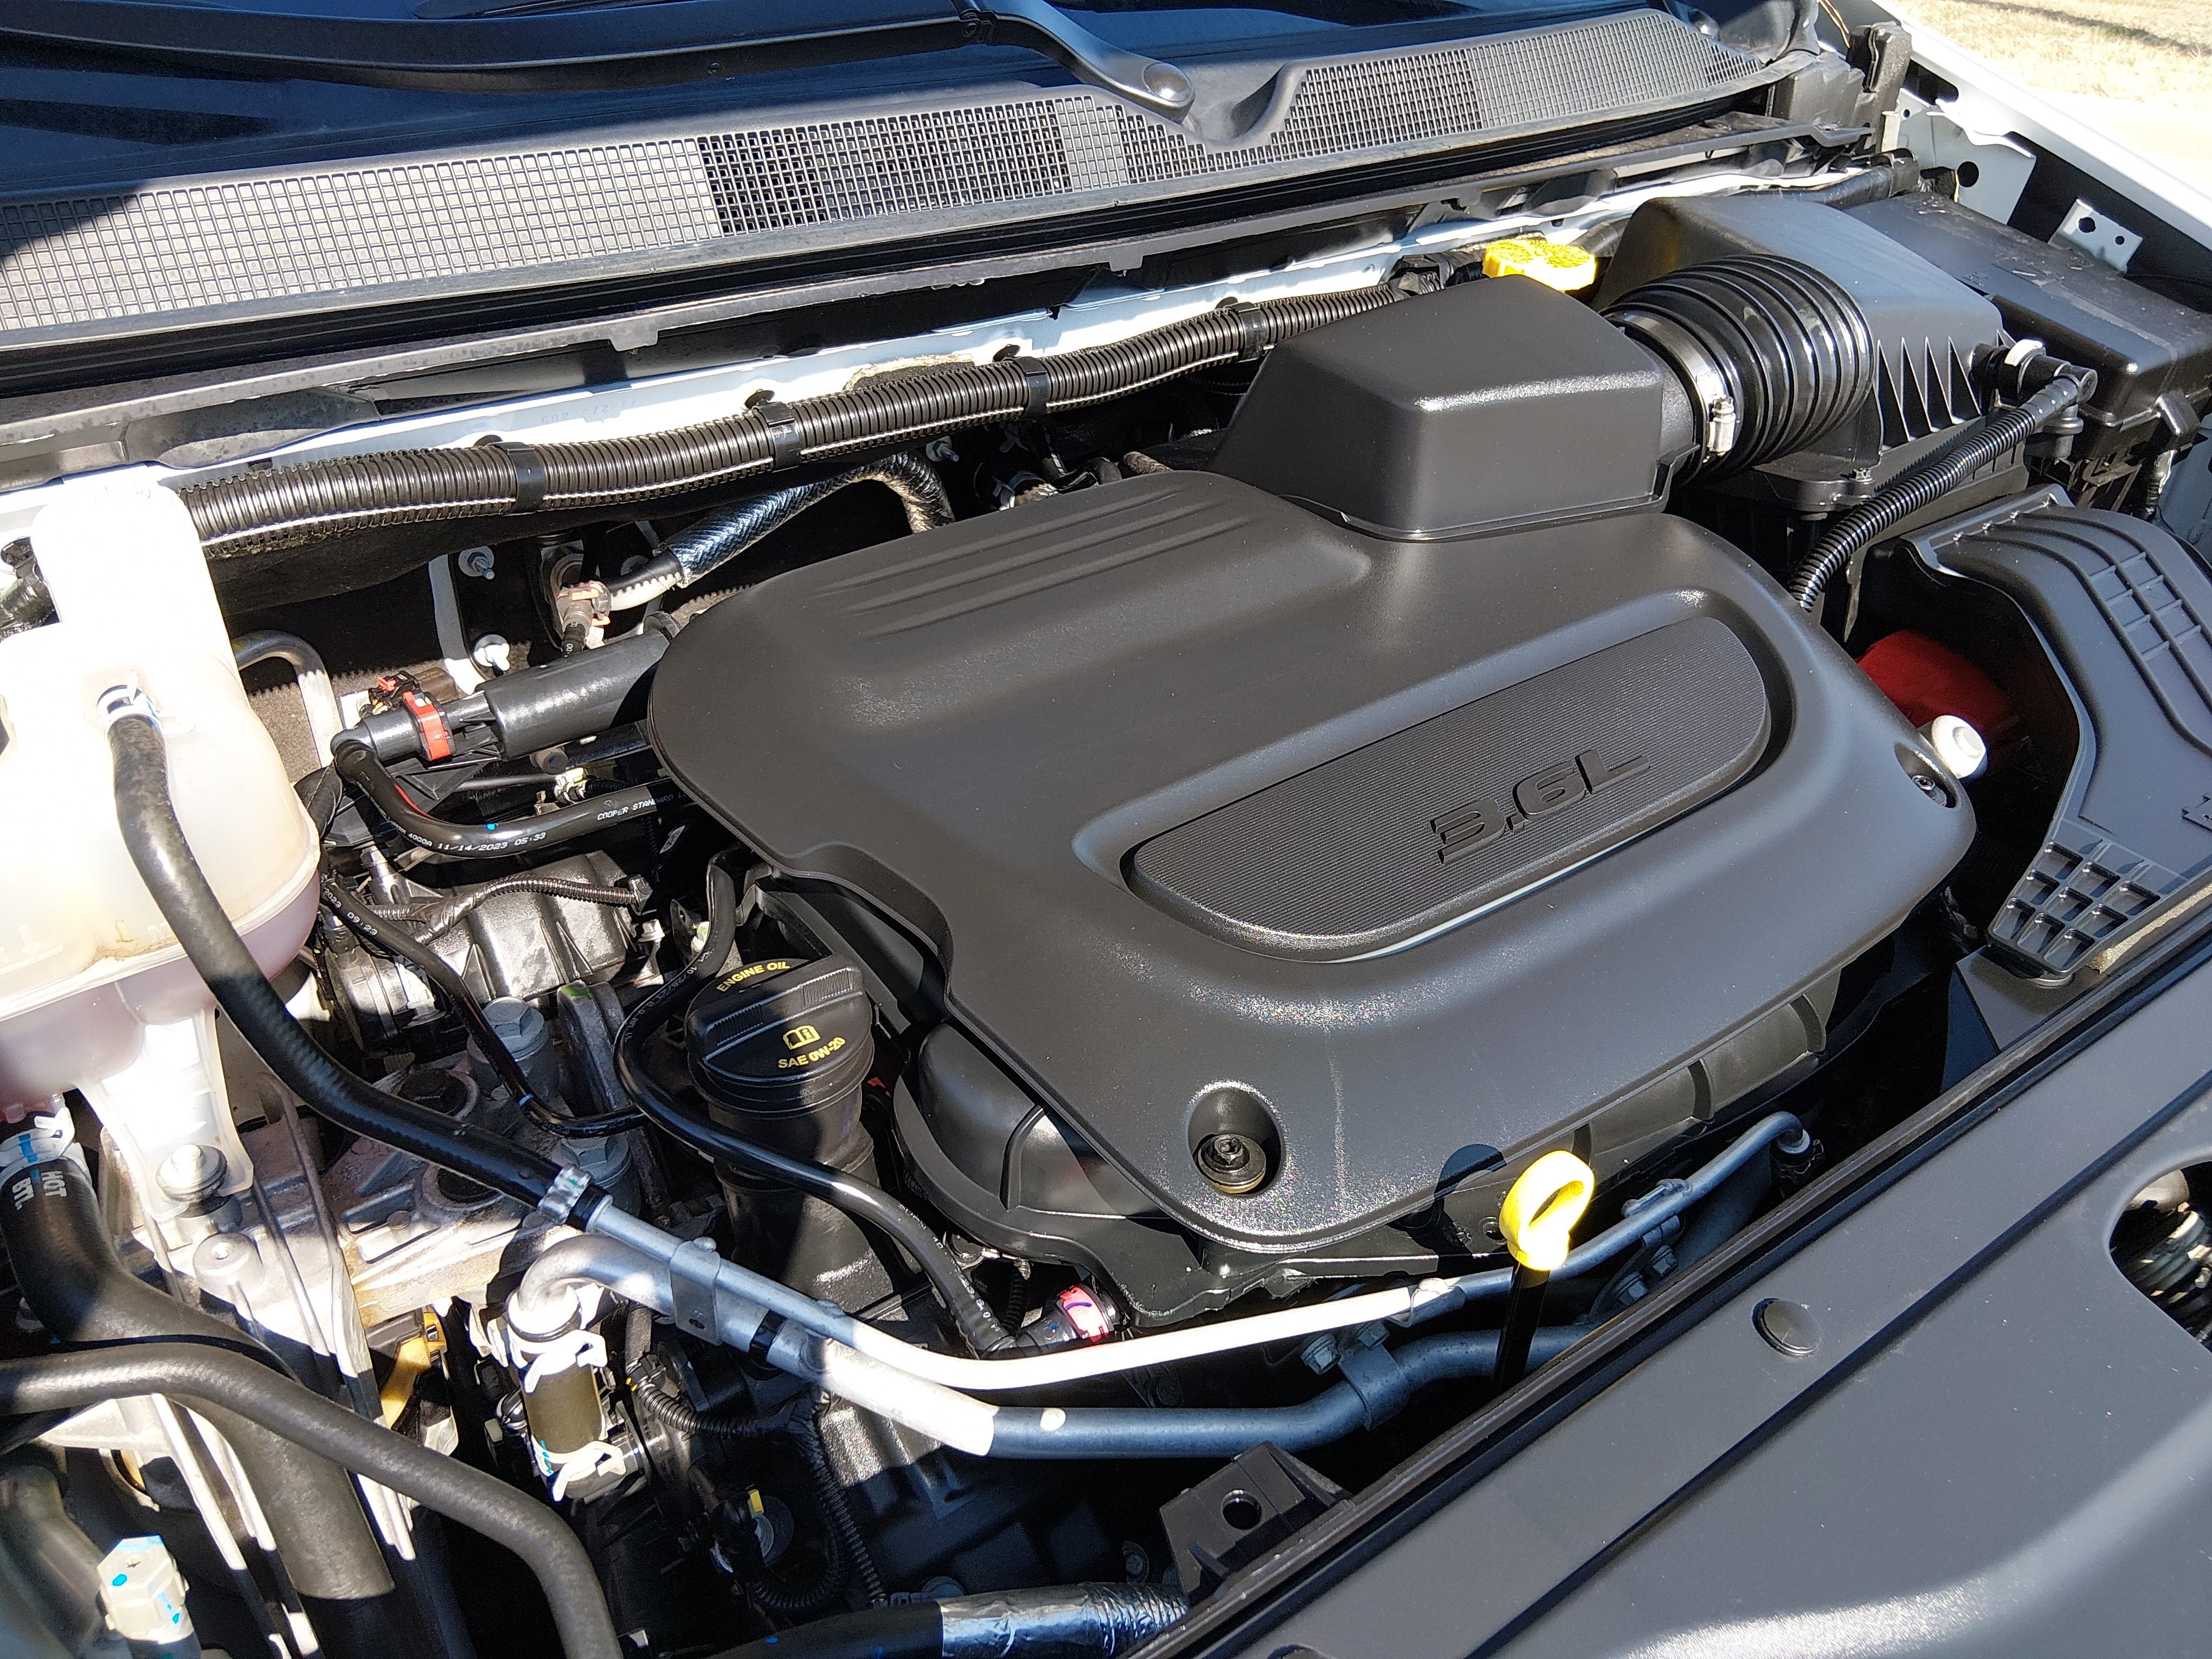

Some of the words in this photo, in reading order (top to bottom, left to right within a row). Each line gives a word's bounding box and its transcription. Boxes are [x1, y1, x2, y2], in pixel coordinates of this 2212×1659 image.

[597, 807, 629, 821] COOPER
[632, 794, 674, 811] STANDARD
[1430, 749, 1650, 865] 3.6L
[437, 843, 507, 852] 11/14/2023
[716, 964, 766, 993] ENGINE
[767, 961, 791, 972] OIL
[777, 1056, 809, 1069] SAE
[808, 1037, 846, 1063] 0W-20
[41, 1171, 67, 1197] HOT
